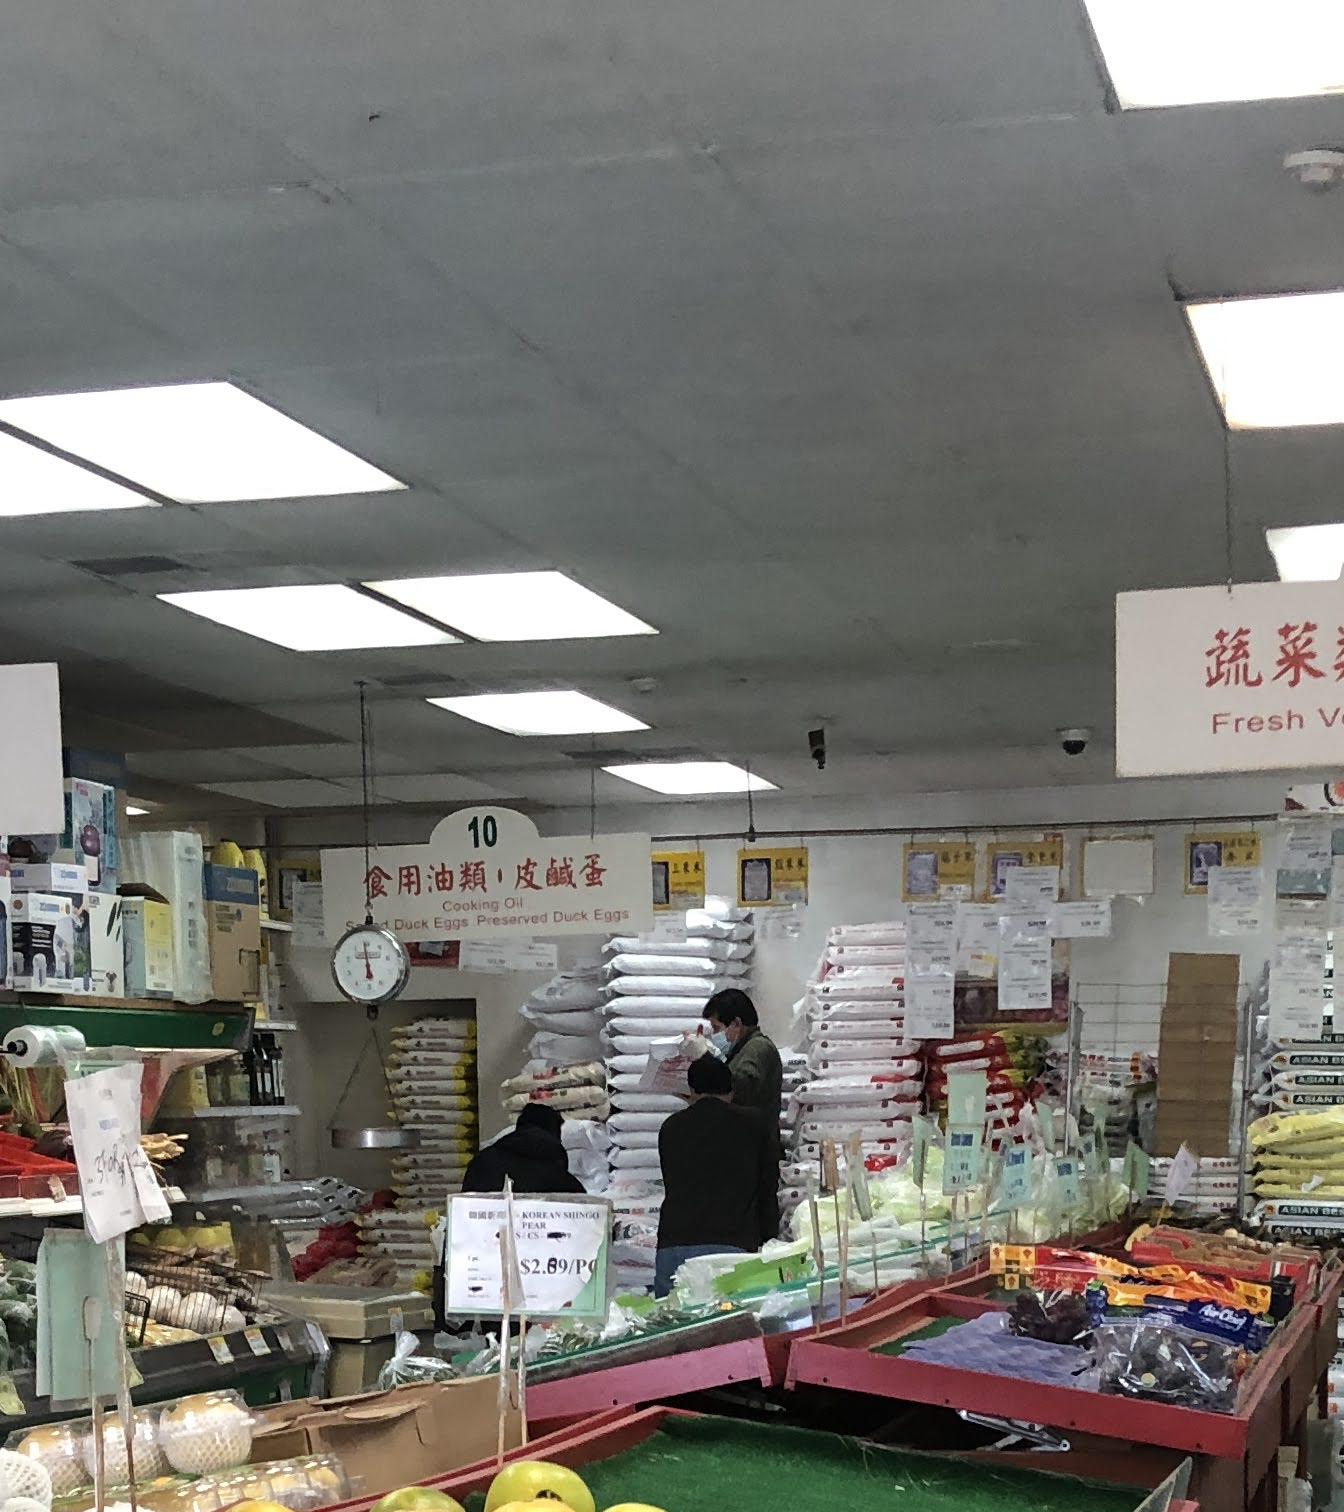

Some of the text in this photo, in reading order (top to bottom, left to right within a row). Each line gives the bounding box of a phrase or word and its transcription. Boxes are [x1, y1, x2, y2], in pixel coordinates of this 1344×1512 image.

[1211, 710, 1304, 735] Fresh
[467, 814, 498, 848] 10
[442, 896, 523, 913] Cooking Oil
[394, 918, 429, 932] Duck
[434, 917, 469, 931] Eggs
[477, 913, 548, 927] Preserved
[553, 911, 589, 924] Duck
[594, 907, 629, 922] Eggs
[1292, 1056, 1328, 1064] ASIAN
[1297, 1076, 1334, 1084] ASIAN
[1295, 1095, 1332, 1104] ASIAN
[522, 1211, 600, 1219] KOREAN SHINGO
[1281, 1207, 1318, 1215] ASIAN
[522, 1221, 546, 1229] PEAR
